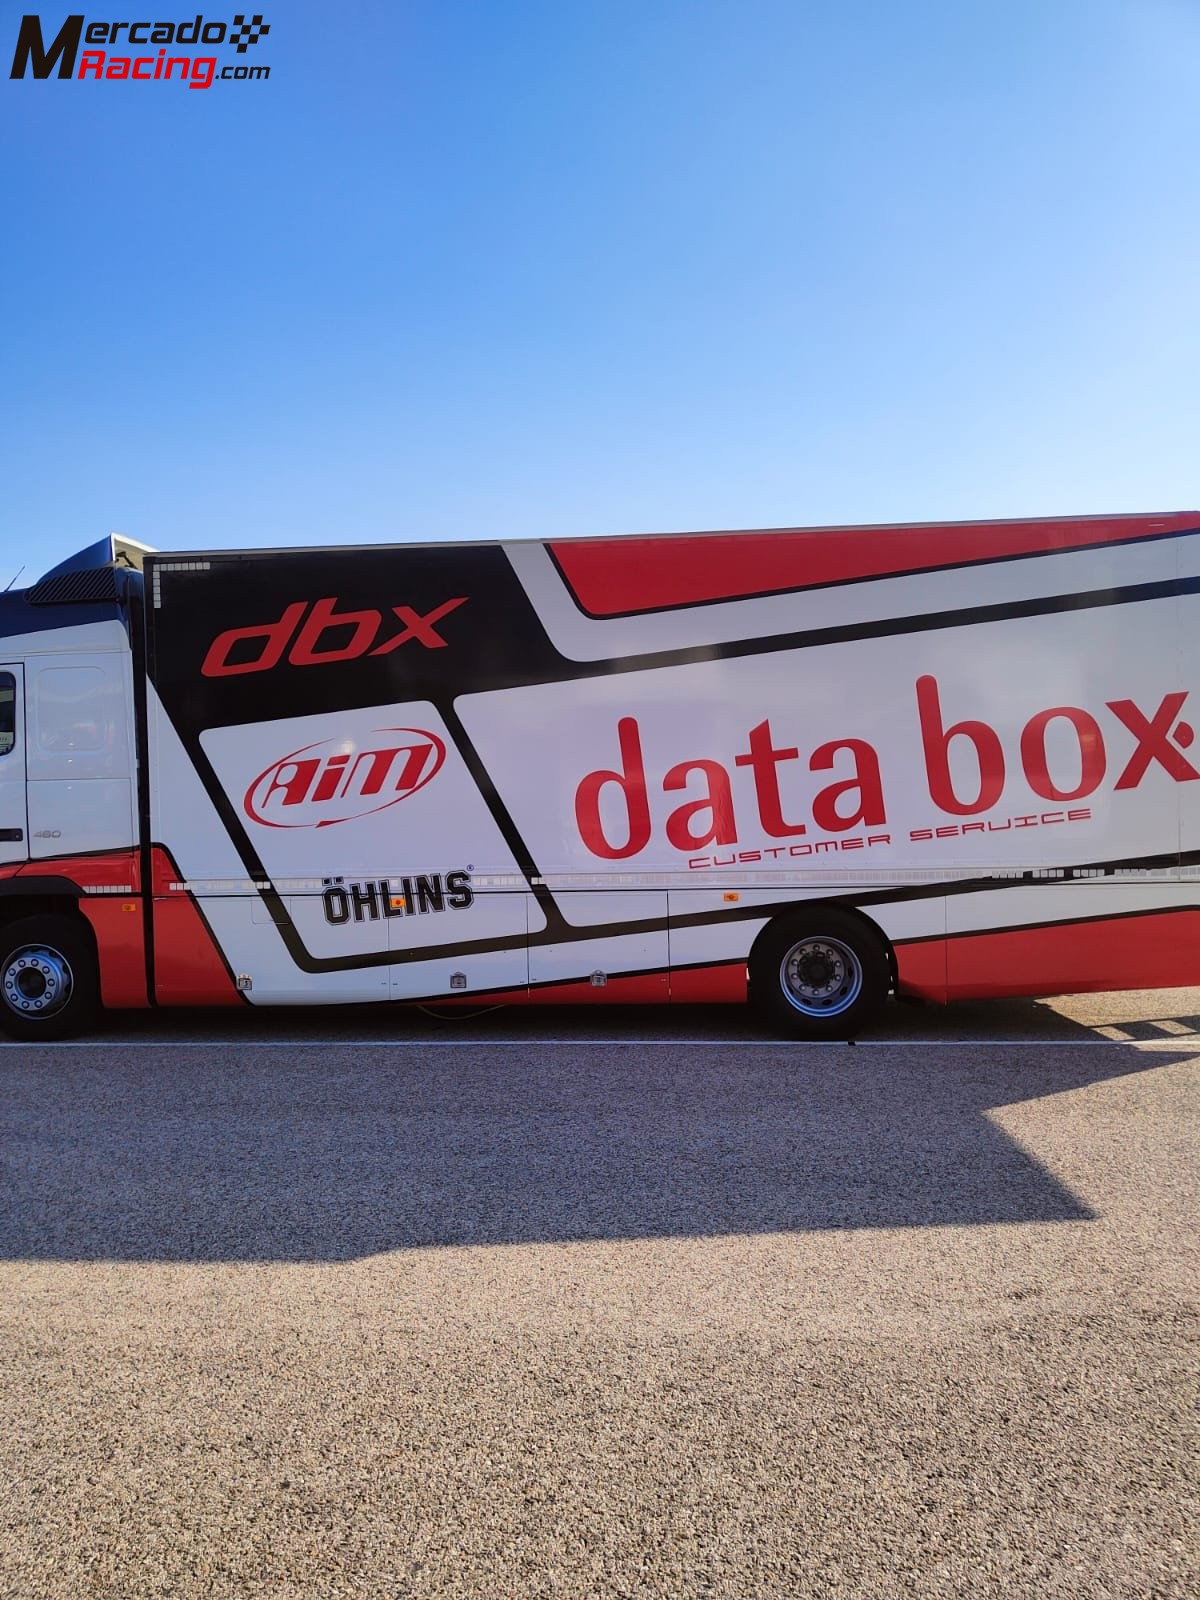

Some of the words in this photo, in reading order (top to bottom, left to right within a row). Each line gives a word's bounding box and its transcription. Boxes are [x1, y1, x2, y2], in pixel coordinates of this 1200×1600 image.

[201, 597, 470, 677] dbx
[575, 717, 886, 859] data
[916, 675, 1200, 815] box
[688, 834, 891, 869] CUSTOMER
[909, 808, 1092, 841] SERVICE
